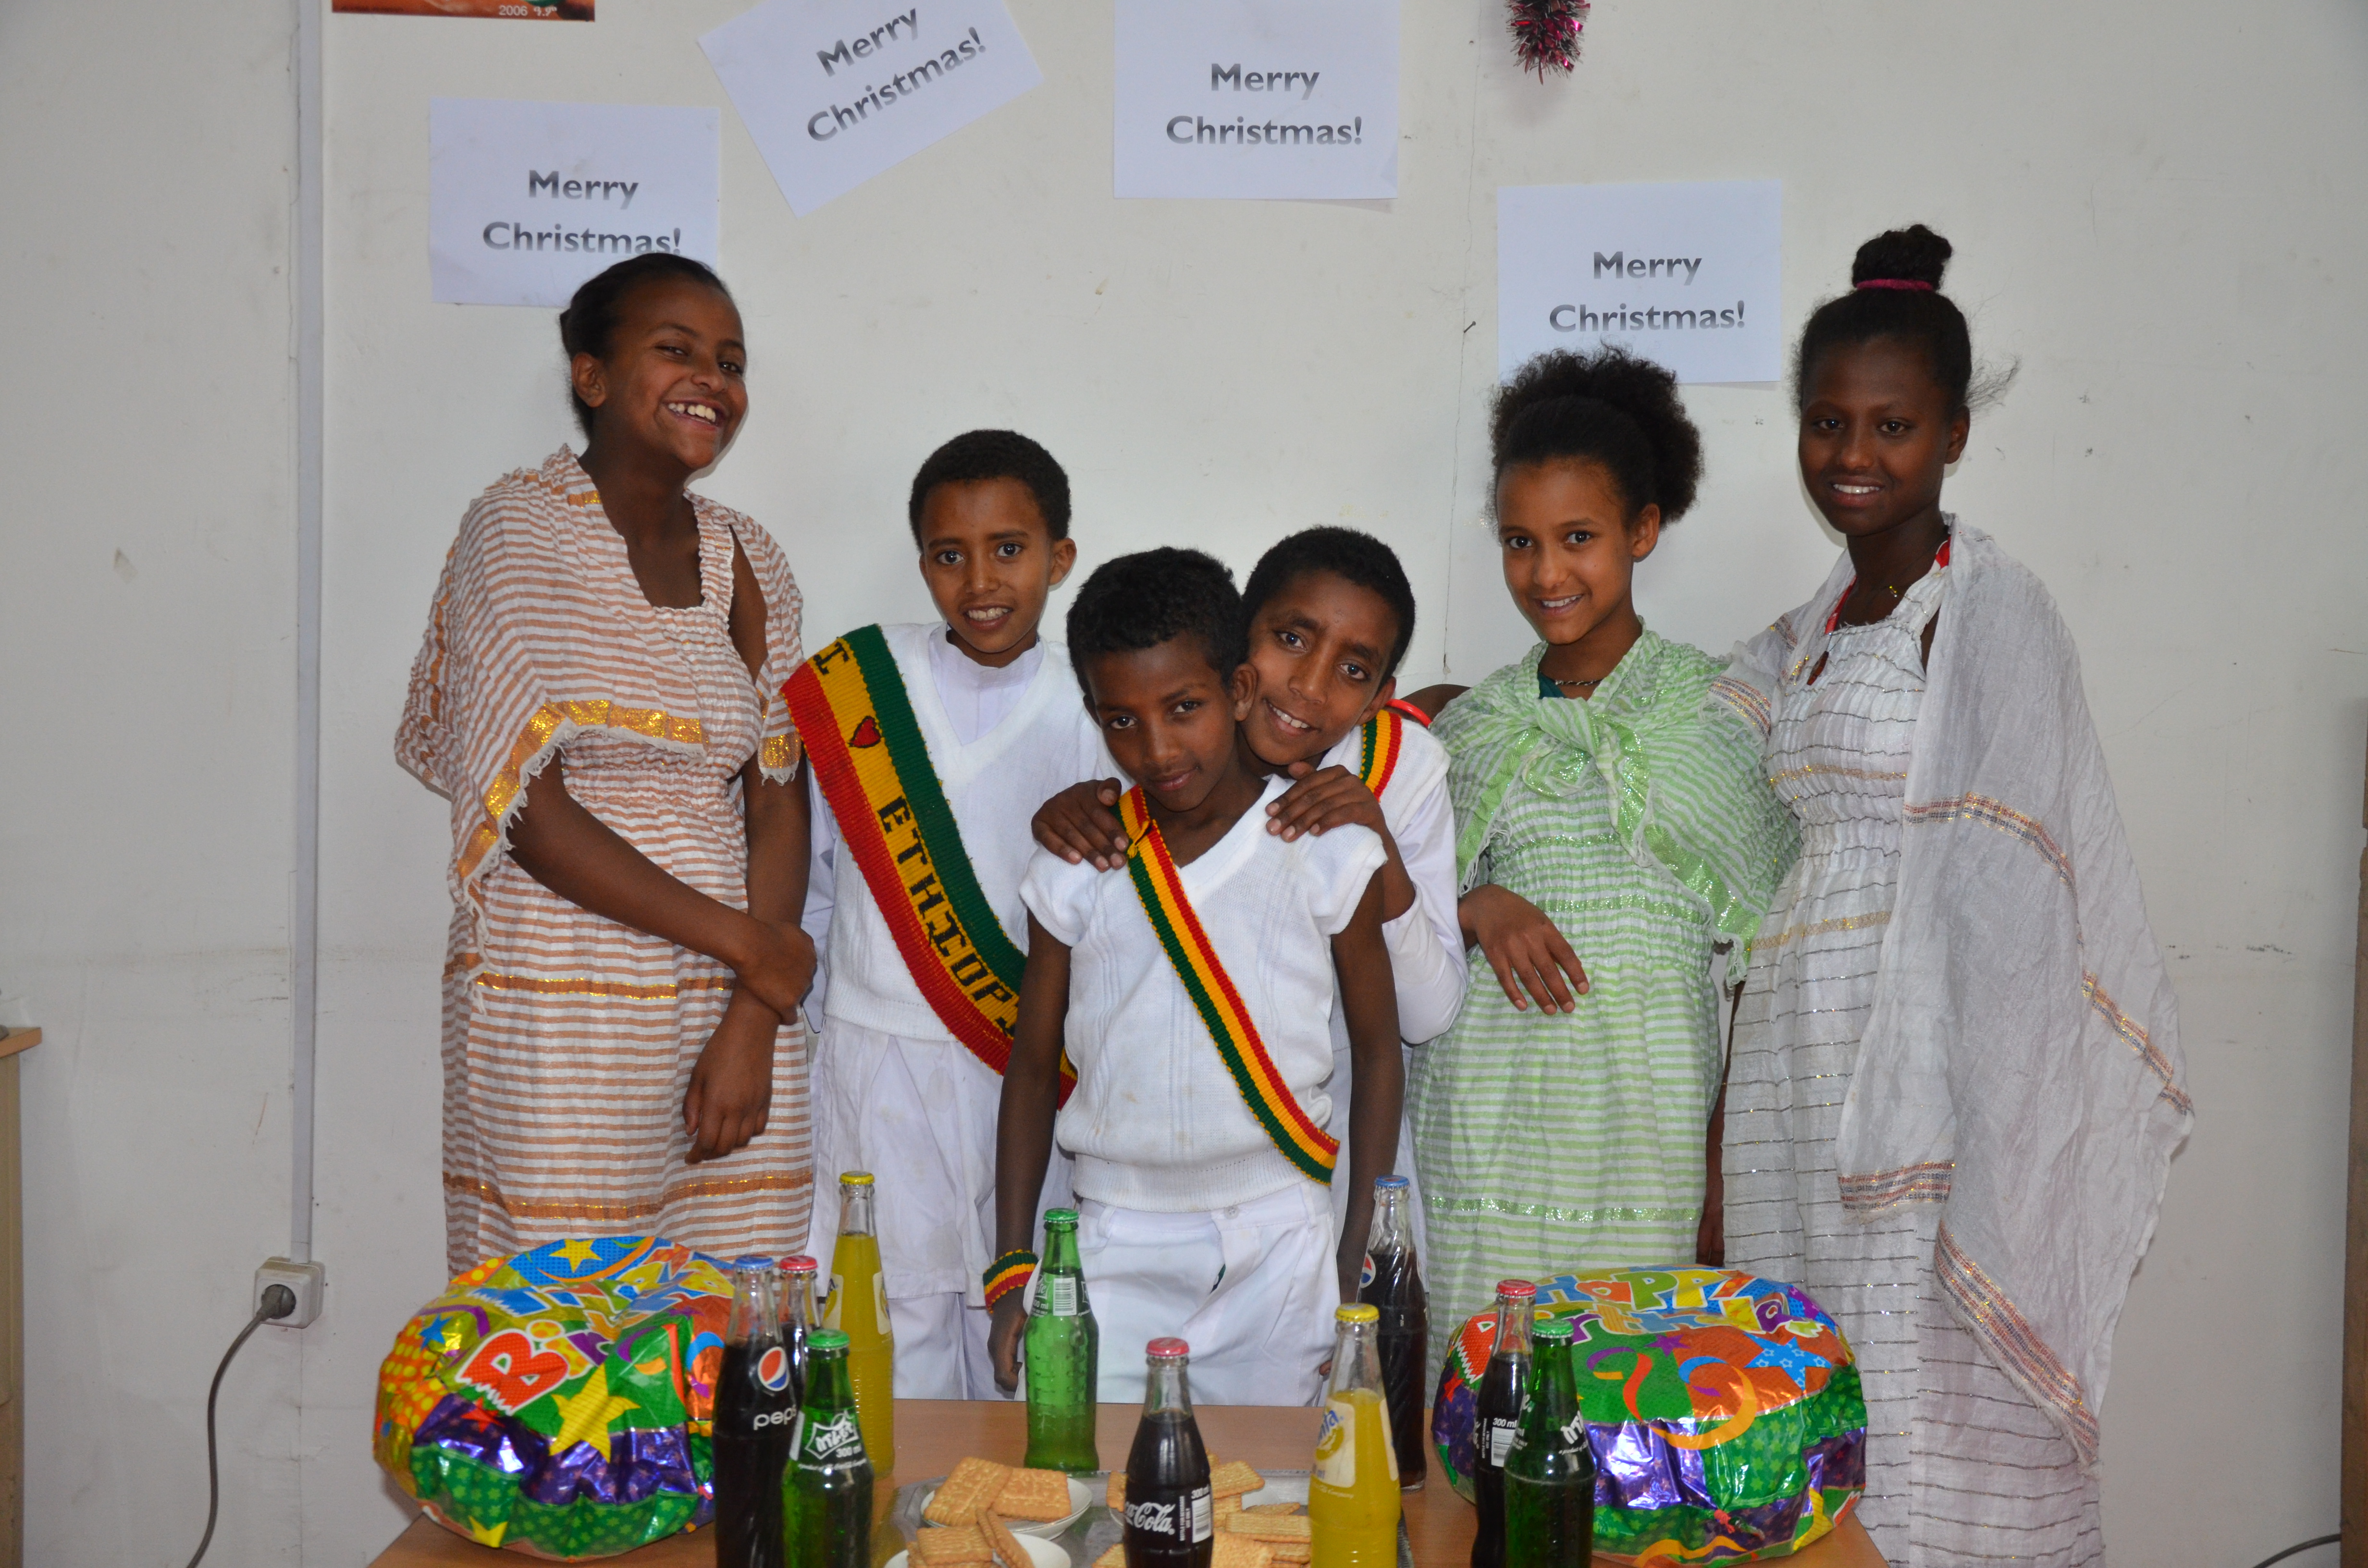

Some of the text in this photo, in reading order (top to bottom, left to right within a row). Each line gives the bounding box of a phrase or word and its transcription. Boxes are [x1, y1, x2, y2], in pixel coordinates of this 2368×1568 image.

[499, 5, 528, 16] 2006
[816, 8, 918, 77] Merry
[807, 27, 986, 141] Christmas!
[1211, 63, 1320, 100] Merry
[1166, 116, 1362, 146] Christmas!
[529, 170, 639, 209] Merry
[482, 221, 681, 254] Christmas!
[1593, 251, 1702, 285] Merry
[1549, 300, 1745, 332] Christmas!
[814, 642, 850, 676] I
[1492, 1418, 1517, 1428] 300 ml
